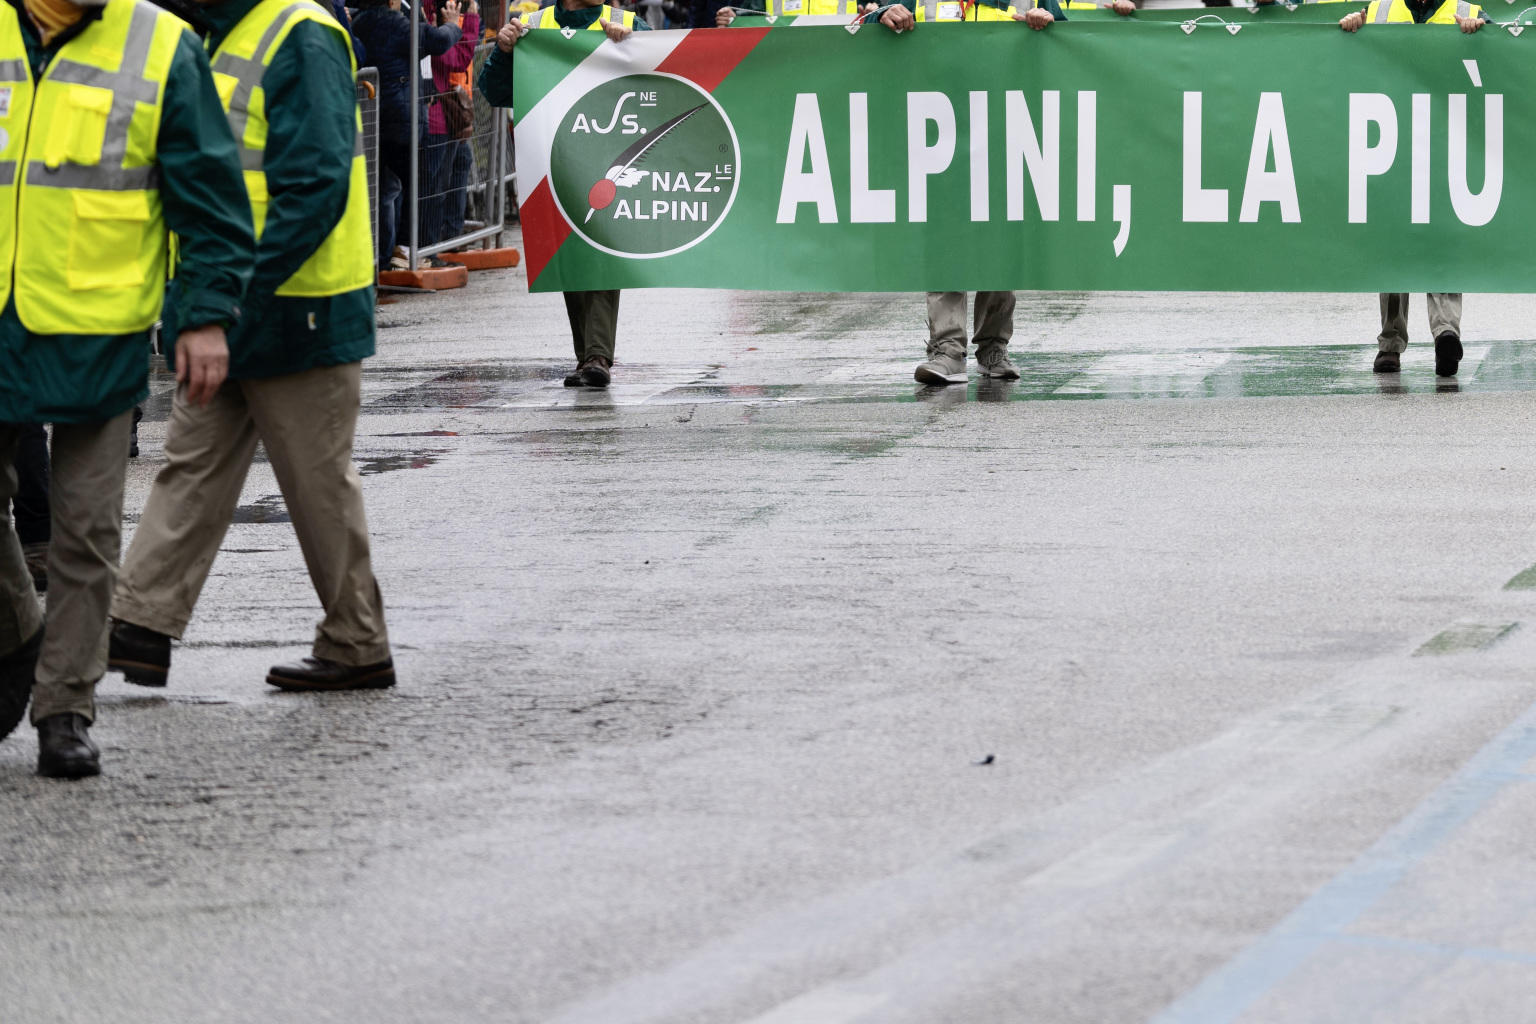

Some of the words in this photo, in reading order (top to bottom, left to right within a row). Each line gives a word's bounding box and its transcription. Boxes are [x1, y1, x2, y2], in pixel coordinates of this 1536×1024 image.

[613, 199, 709, 222] ALPINI
[776, 91, 1131, 257] ALPINI,
[1182, 92, 1302, 224] LA
[1348, 59, 1504, 227] PIÙ
